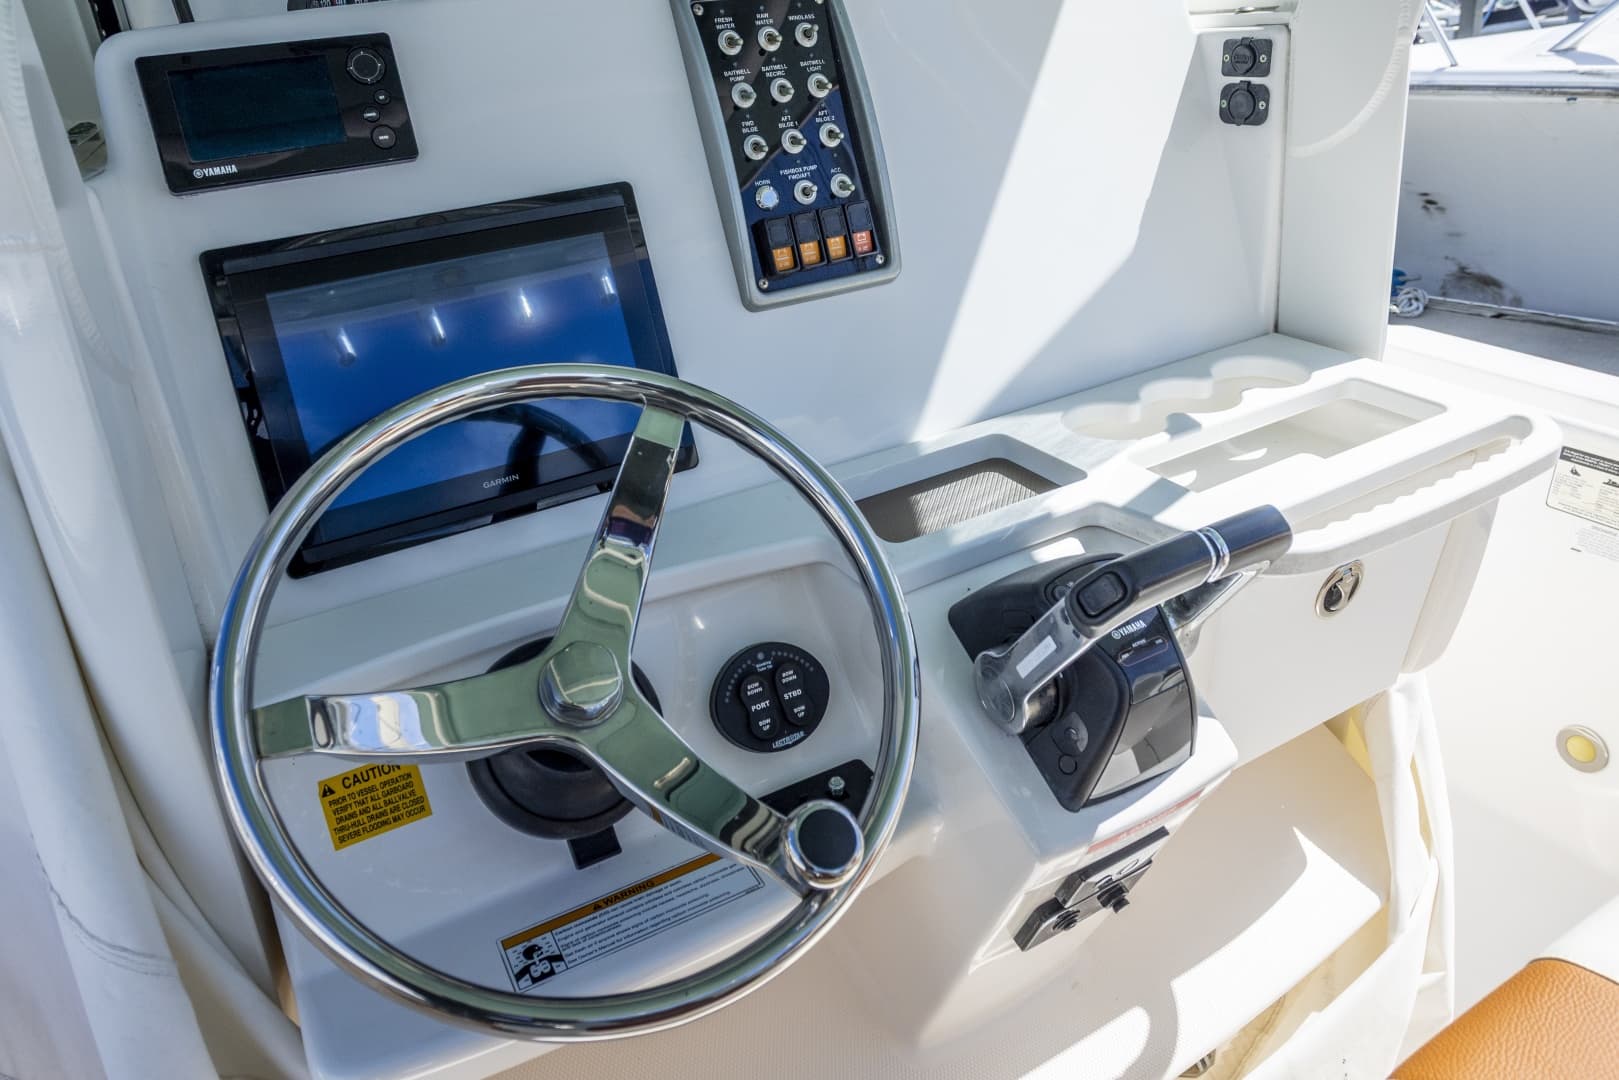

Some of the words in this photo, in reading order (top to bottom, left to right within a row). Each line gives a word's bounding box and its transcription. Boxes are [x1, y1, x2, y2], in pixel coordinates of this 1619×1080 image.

[724, 68, 751, 76] BAITWELL
[203, 164, 238, 178] YAMAHA
[780, 166, 803, 176] FISHBOX
[483, 473, 519, 488] GARMIN
[1119, 619, 1147, 636] YAMAHA
[782, 669, 794, 677] BOW
[781, 675, 797, 684] DOWN
[747, 682, 759, 690] BOW
[747, 687, 762, 696] DOWN
[783, 689, 802, 700] STBD
[751, 700, 770, 712] PORT
[793, 705, 806, 713] BOW
[759, 718, 771, 726] BOW
[328, 794, 347, 807] PRIOR
[348, 791, 356, 799] TO
[356, 784, 379, 797] VESSEL
[379, 772, 412, 790] OPERATION
[332, 803, 353, 816] VERIFY
[354, 797, 368, 808] THAT
[370, 793, 382, 802] ALL
[382, 780, 414, 797] GARBOARD
[335, 811, 358, 825] DRAINS
[359, 805, 371, 816] AND
[372, 803, 383, 813] ALL
[367, 809, 388, 823] DRAINS
[390, 804, 401, 814] ARE
[401, 795, 425, 809] CLOSED
[338, 829, 362, 844] SEVERE
[362, 819, 392, 836] FLOODING
[391, 813, 404, 824] MAY
[405, 804, 426, 818] OCCUR
[601, 880, 656, 906] WARNING
